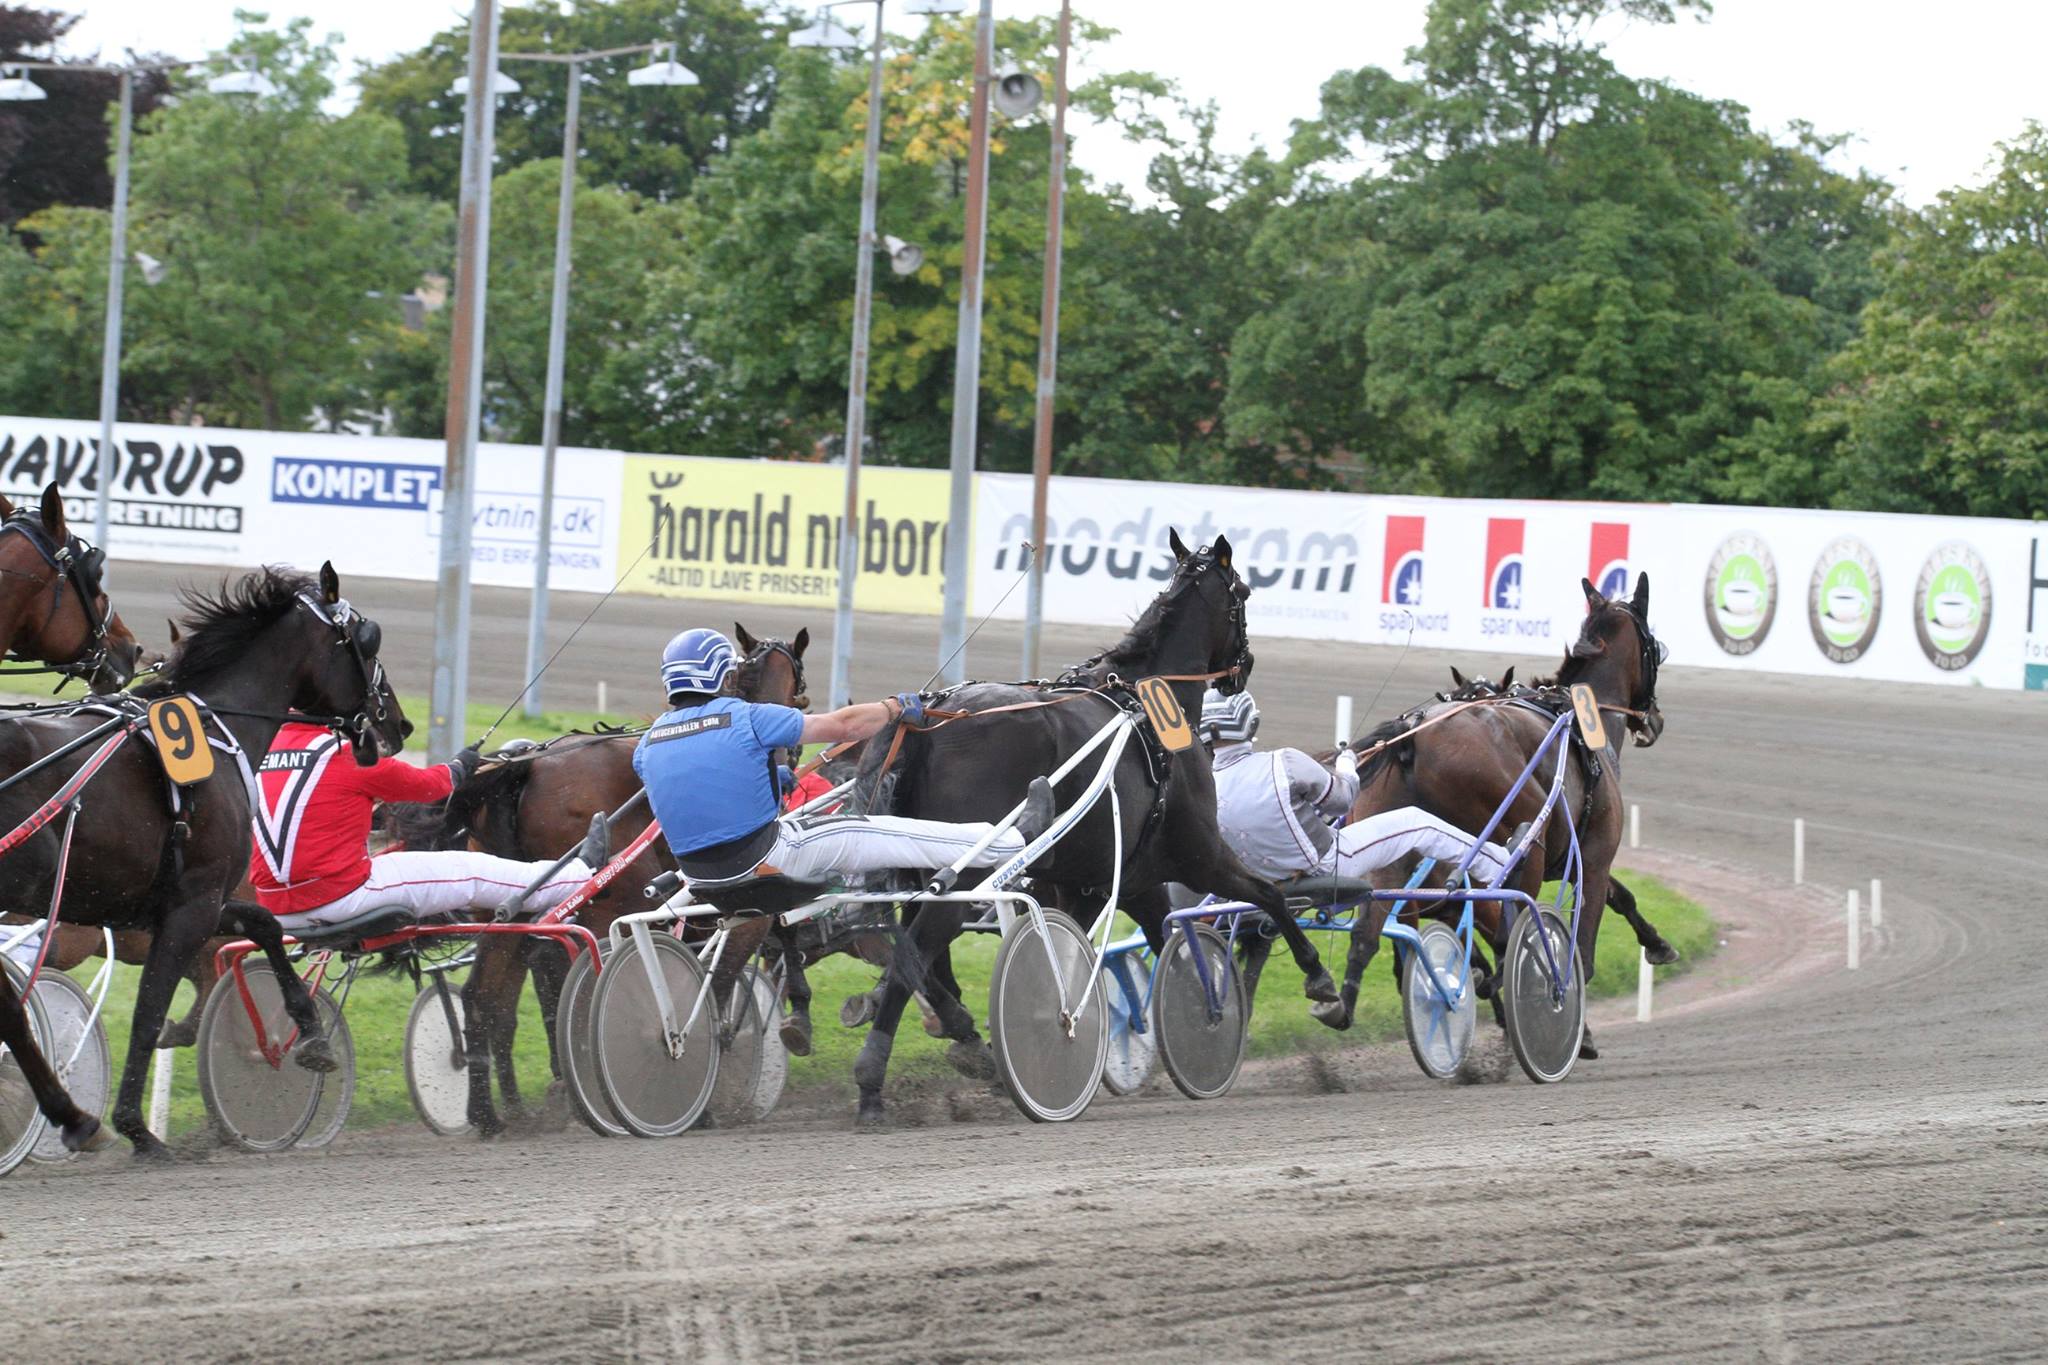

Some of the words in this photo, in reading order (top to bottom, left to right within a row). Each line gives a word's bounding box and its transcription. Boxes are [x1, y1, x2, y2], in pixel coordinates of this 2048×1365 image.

[275, 463, 437, 504] KOMPLET
[649, 493, 791, 567] harald
[806, 499, 950, 594] nbor
[710, 573, 751, 591] LAVE
[1141, 681, 1182, 732] 10
[1577, 687, 1597, 732] 3
[158, 702, 195, 760] 9
[992, 857, 1025, 889] CUSTOM
